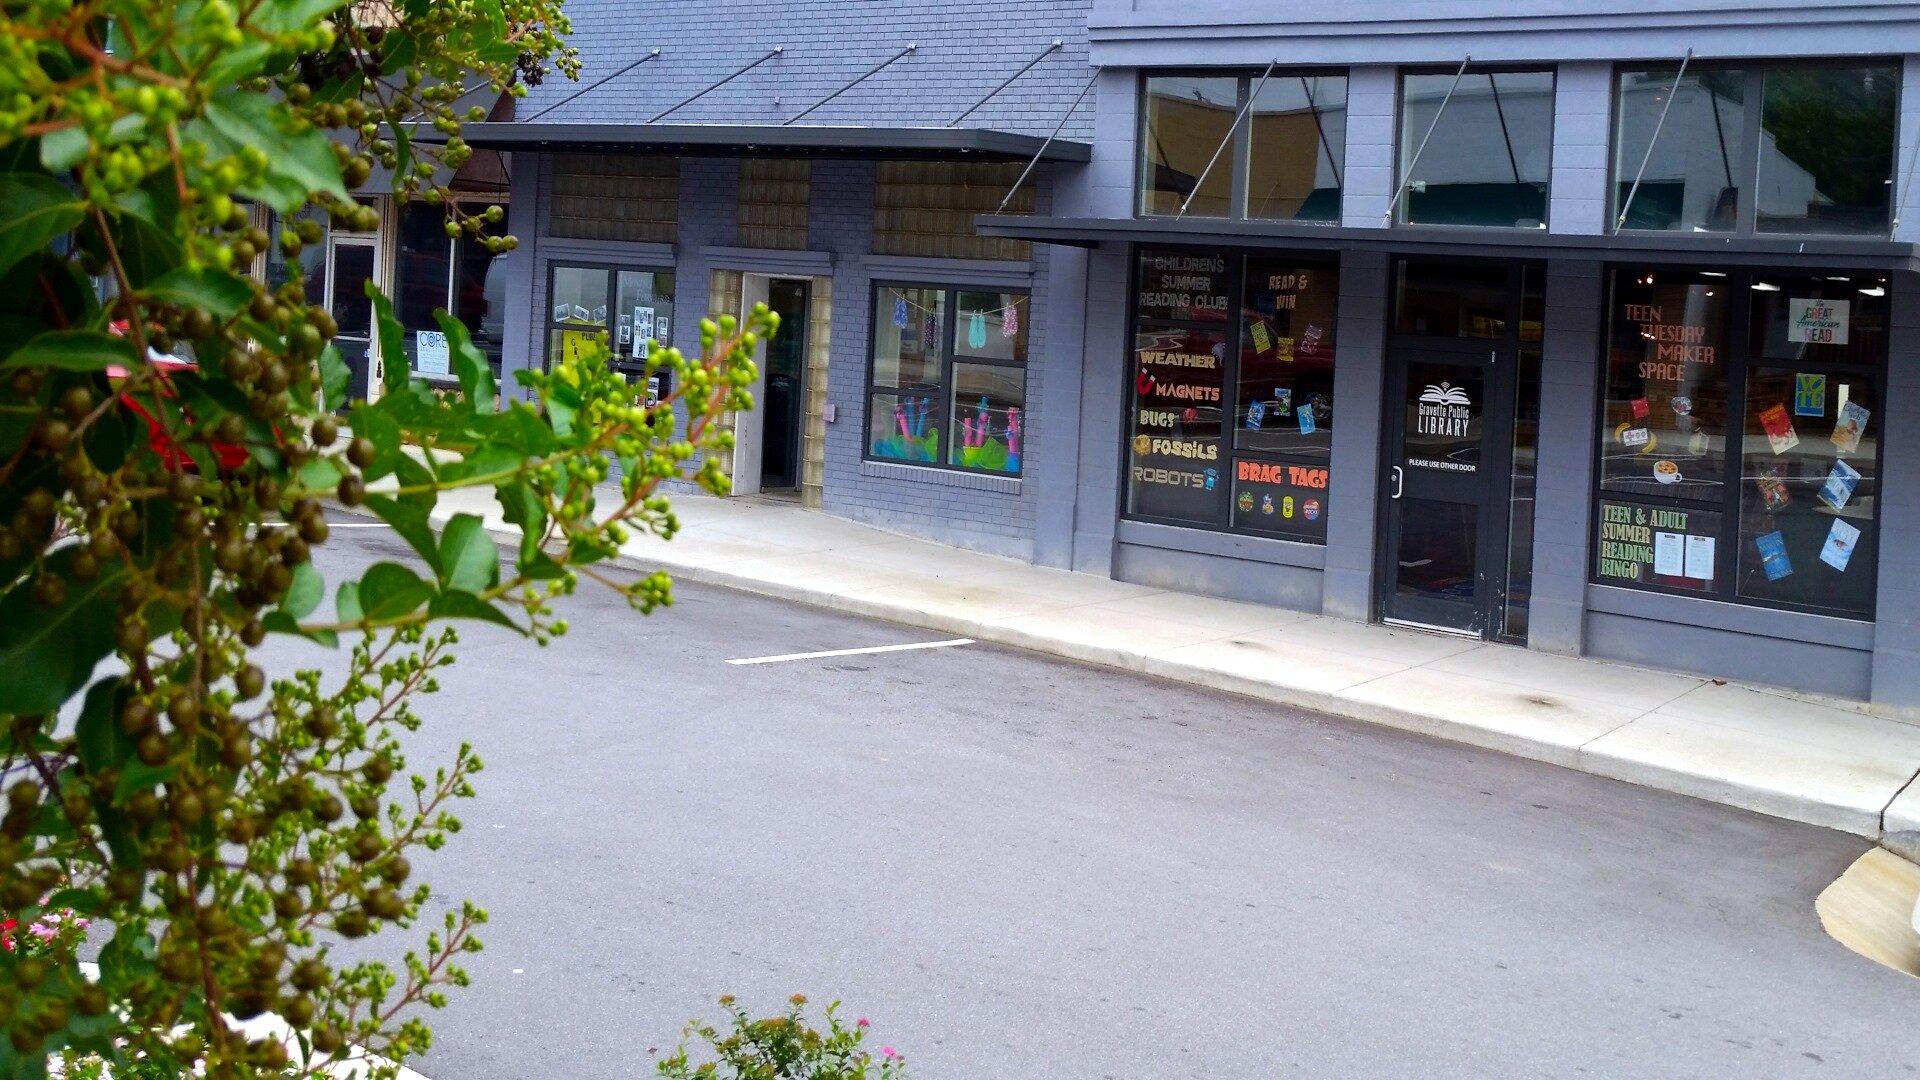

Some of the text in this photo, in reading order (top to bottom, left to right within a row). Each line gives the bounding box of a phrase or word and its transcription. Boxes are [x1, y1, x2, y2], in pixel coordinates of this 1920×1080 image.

[1161, 274, 1211, 291] SUMMER
[1269, 274, 1307, 290] READ &
[1140, 292, 1190, 307] READING
[1276, 294, 1296, 310] WIN
[1624, 304, 1662, 322] TEEN
[1805, 307, 1833, 320] GREAT
[1640, 324, 1705, 343] TUESDAY
[1804, 328, 1832, 342] READ
[1140, 351, 1215, 369] WEATHER
[1657, 343, 1714, 364] MAKER
[1638, 361, 1685, 382] SPACE
[1156, 383, 1220, 401] MAGNETS
[1140, 410, 1175, 428] BUGS
[1419, 402, 1470, 420] Gravette Public
[1418, 415, 1469, 437] LIBRARY
[1408, 458, 1428, 467] PLEASE
[1440, 462, 1458, 471] OTHER
[1459, 464, 1476, 472] DOOR
[1133, 466, 1204, 488] ROBOTS
[1238, 461, 1328, 489] BRAG TAGS
[1603, 504, 1688, 529] TEEN & ADULT
[1602, 522, 1651, 544] SUMMER
[1602, 540, 1654, 564] READING
[1600, 558, 1639, 579] BINGO
